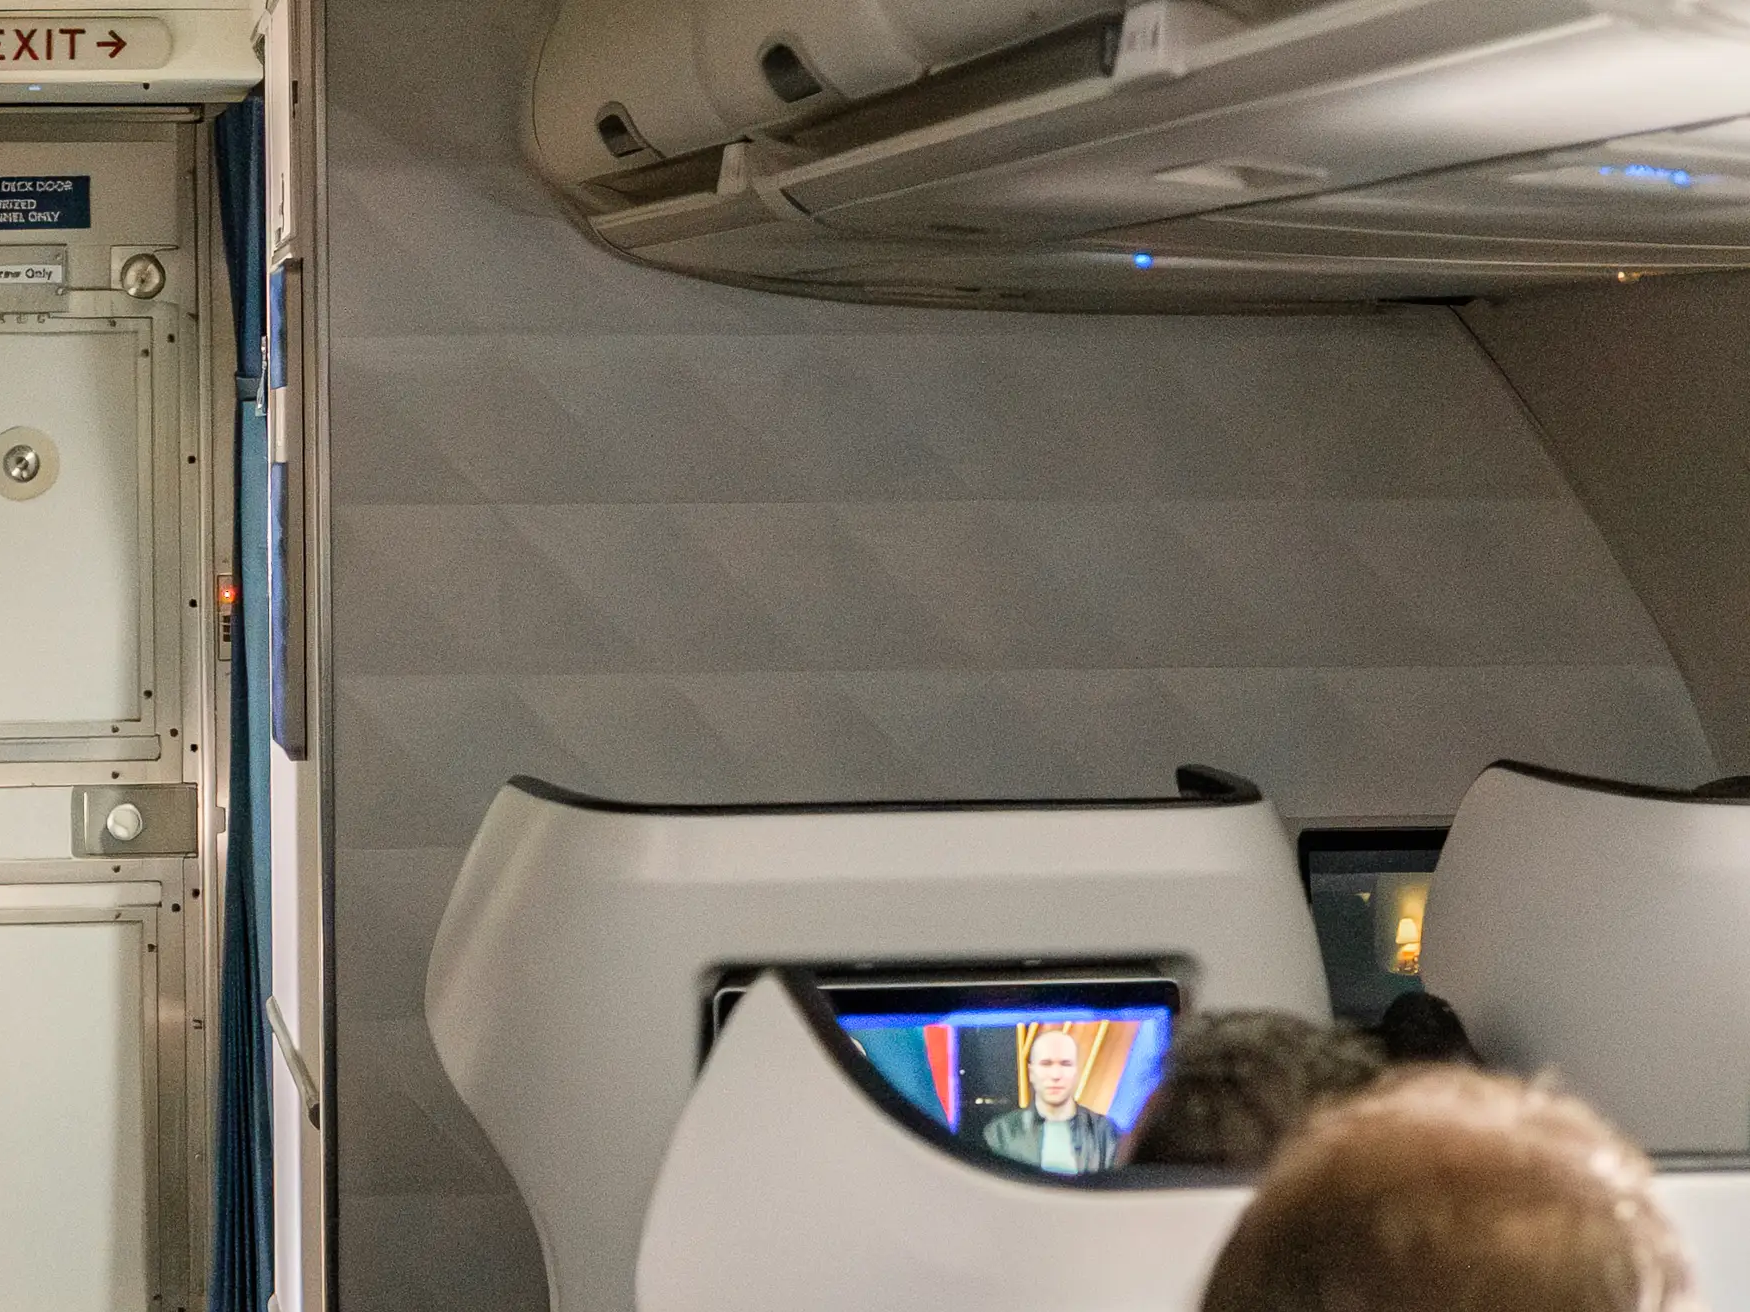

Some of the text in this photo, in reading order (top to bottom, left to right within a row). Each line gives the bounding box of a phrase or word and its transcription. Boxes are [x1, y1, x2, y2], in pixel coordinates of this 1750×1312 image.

[1, 181, 34, 193] DECK
[36, 180, 73, 192] DOOR
[28, 211, 61, 222] ONLY
[25, 268, 53, 280] Only
